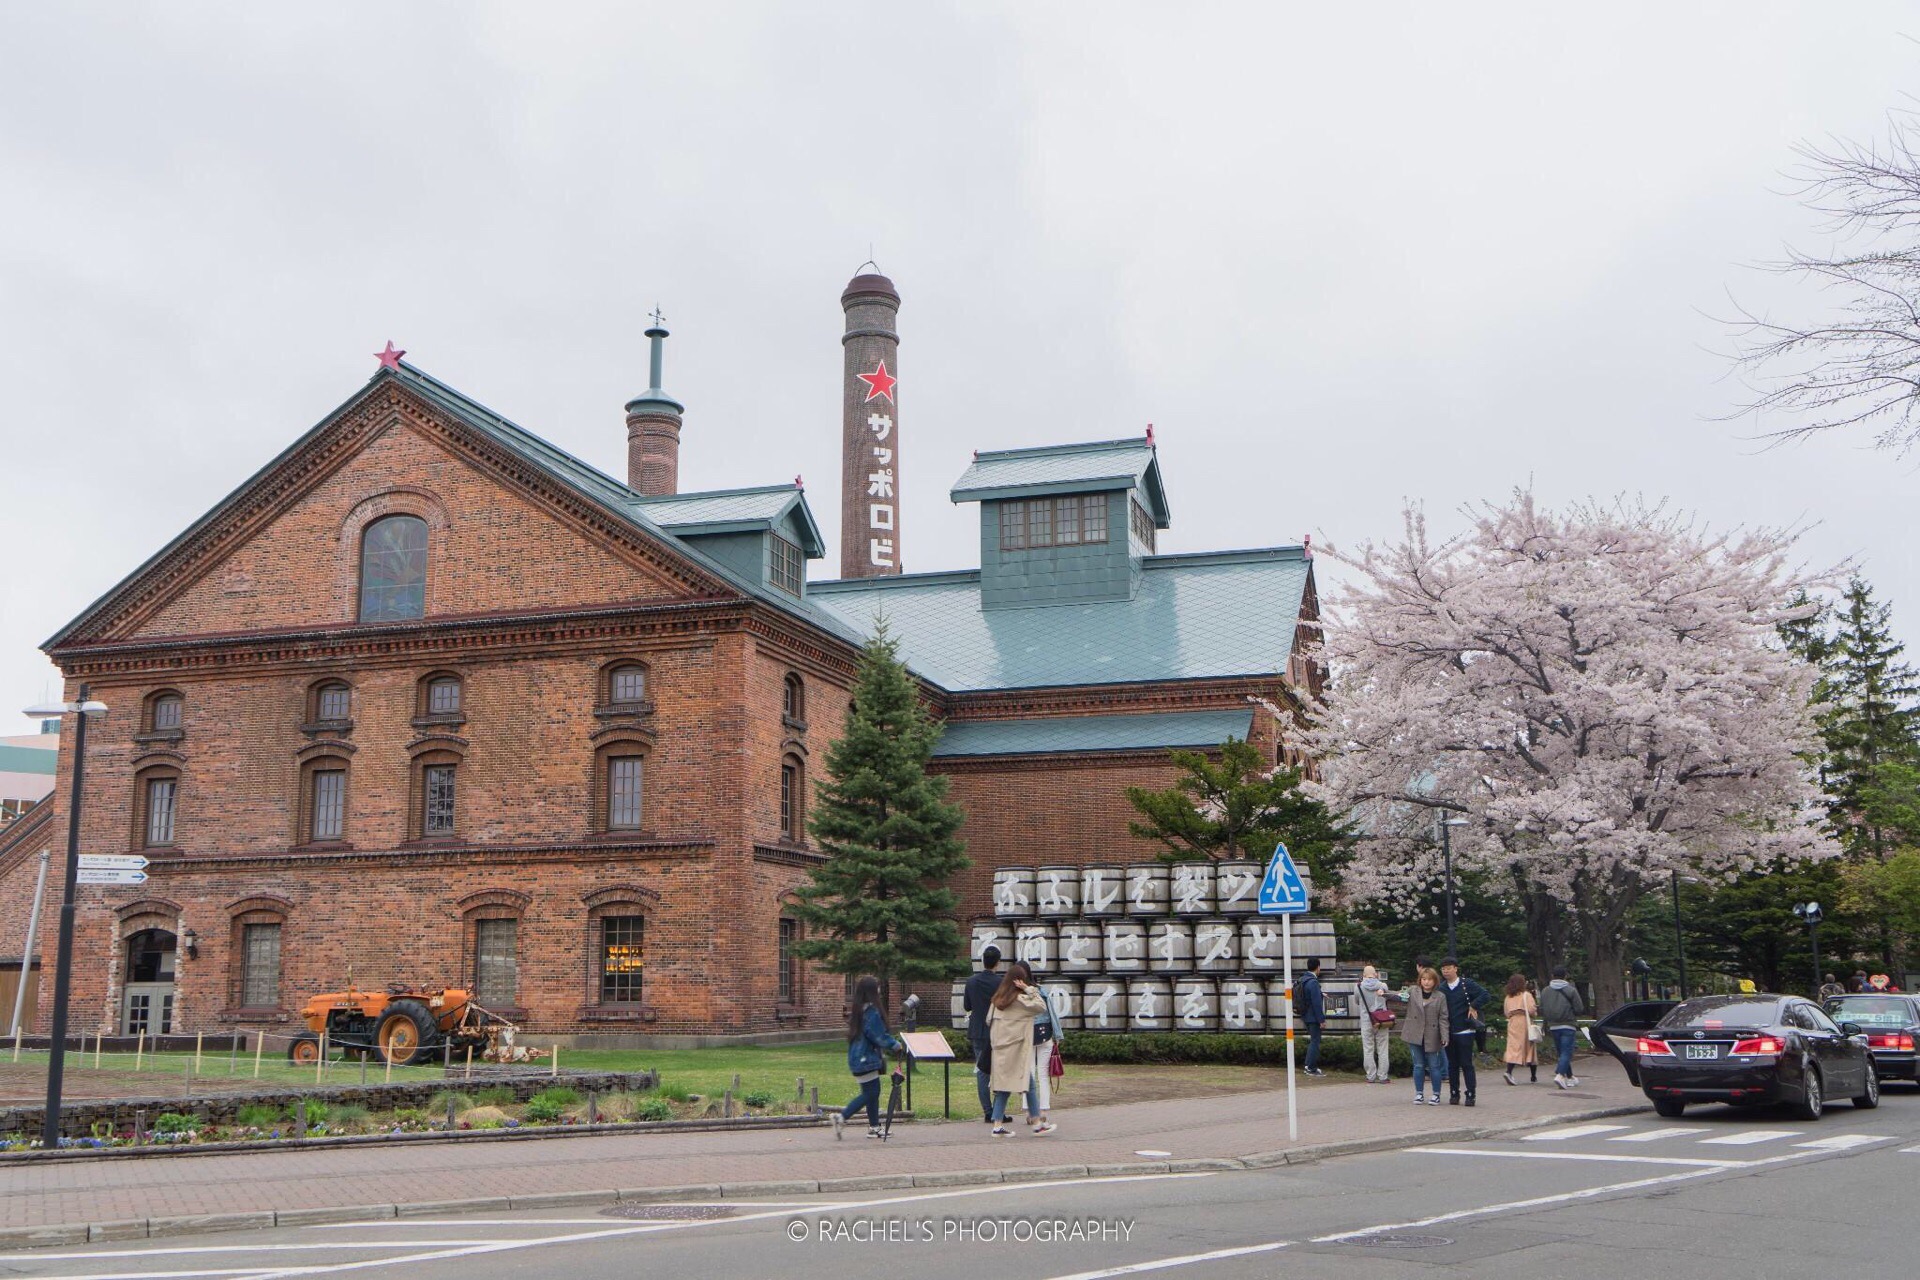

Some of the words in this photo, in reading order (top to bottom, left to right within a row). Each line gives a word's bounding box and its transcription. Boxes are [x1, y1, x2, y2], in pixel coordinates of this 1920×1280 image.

[867, 412, 893, 577] サッポロビ
